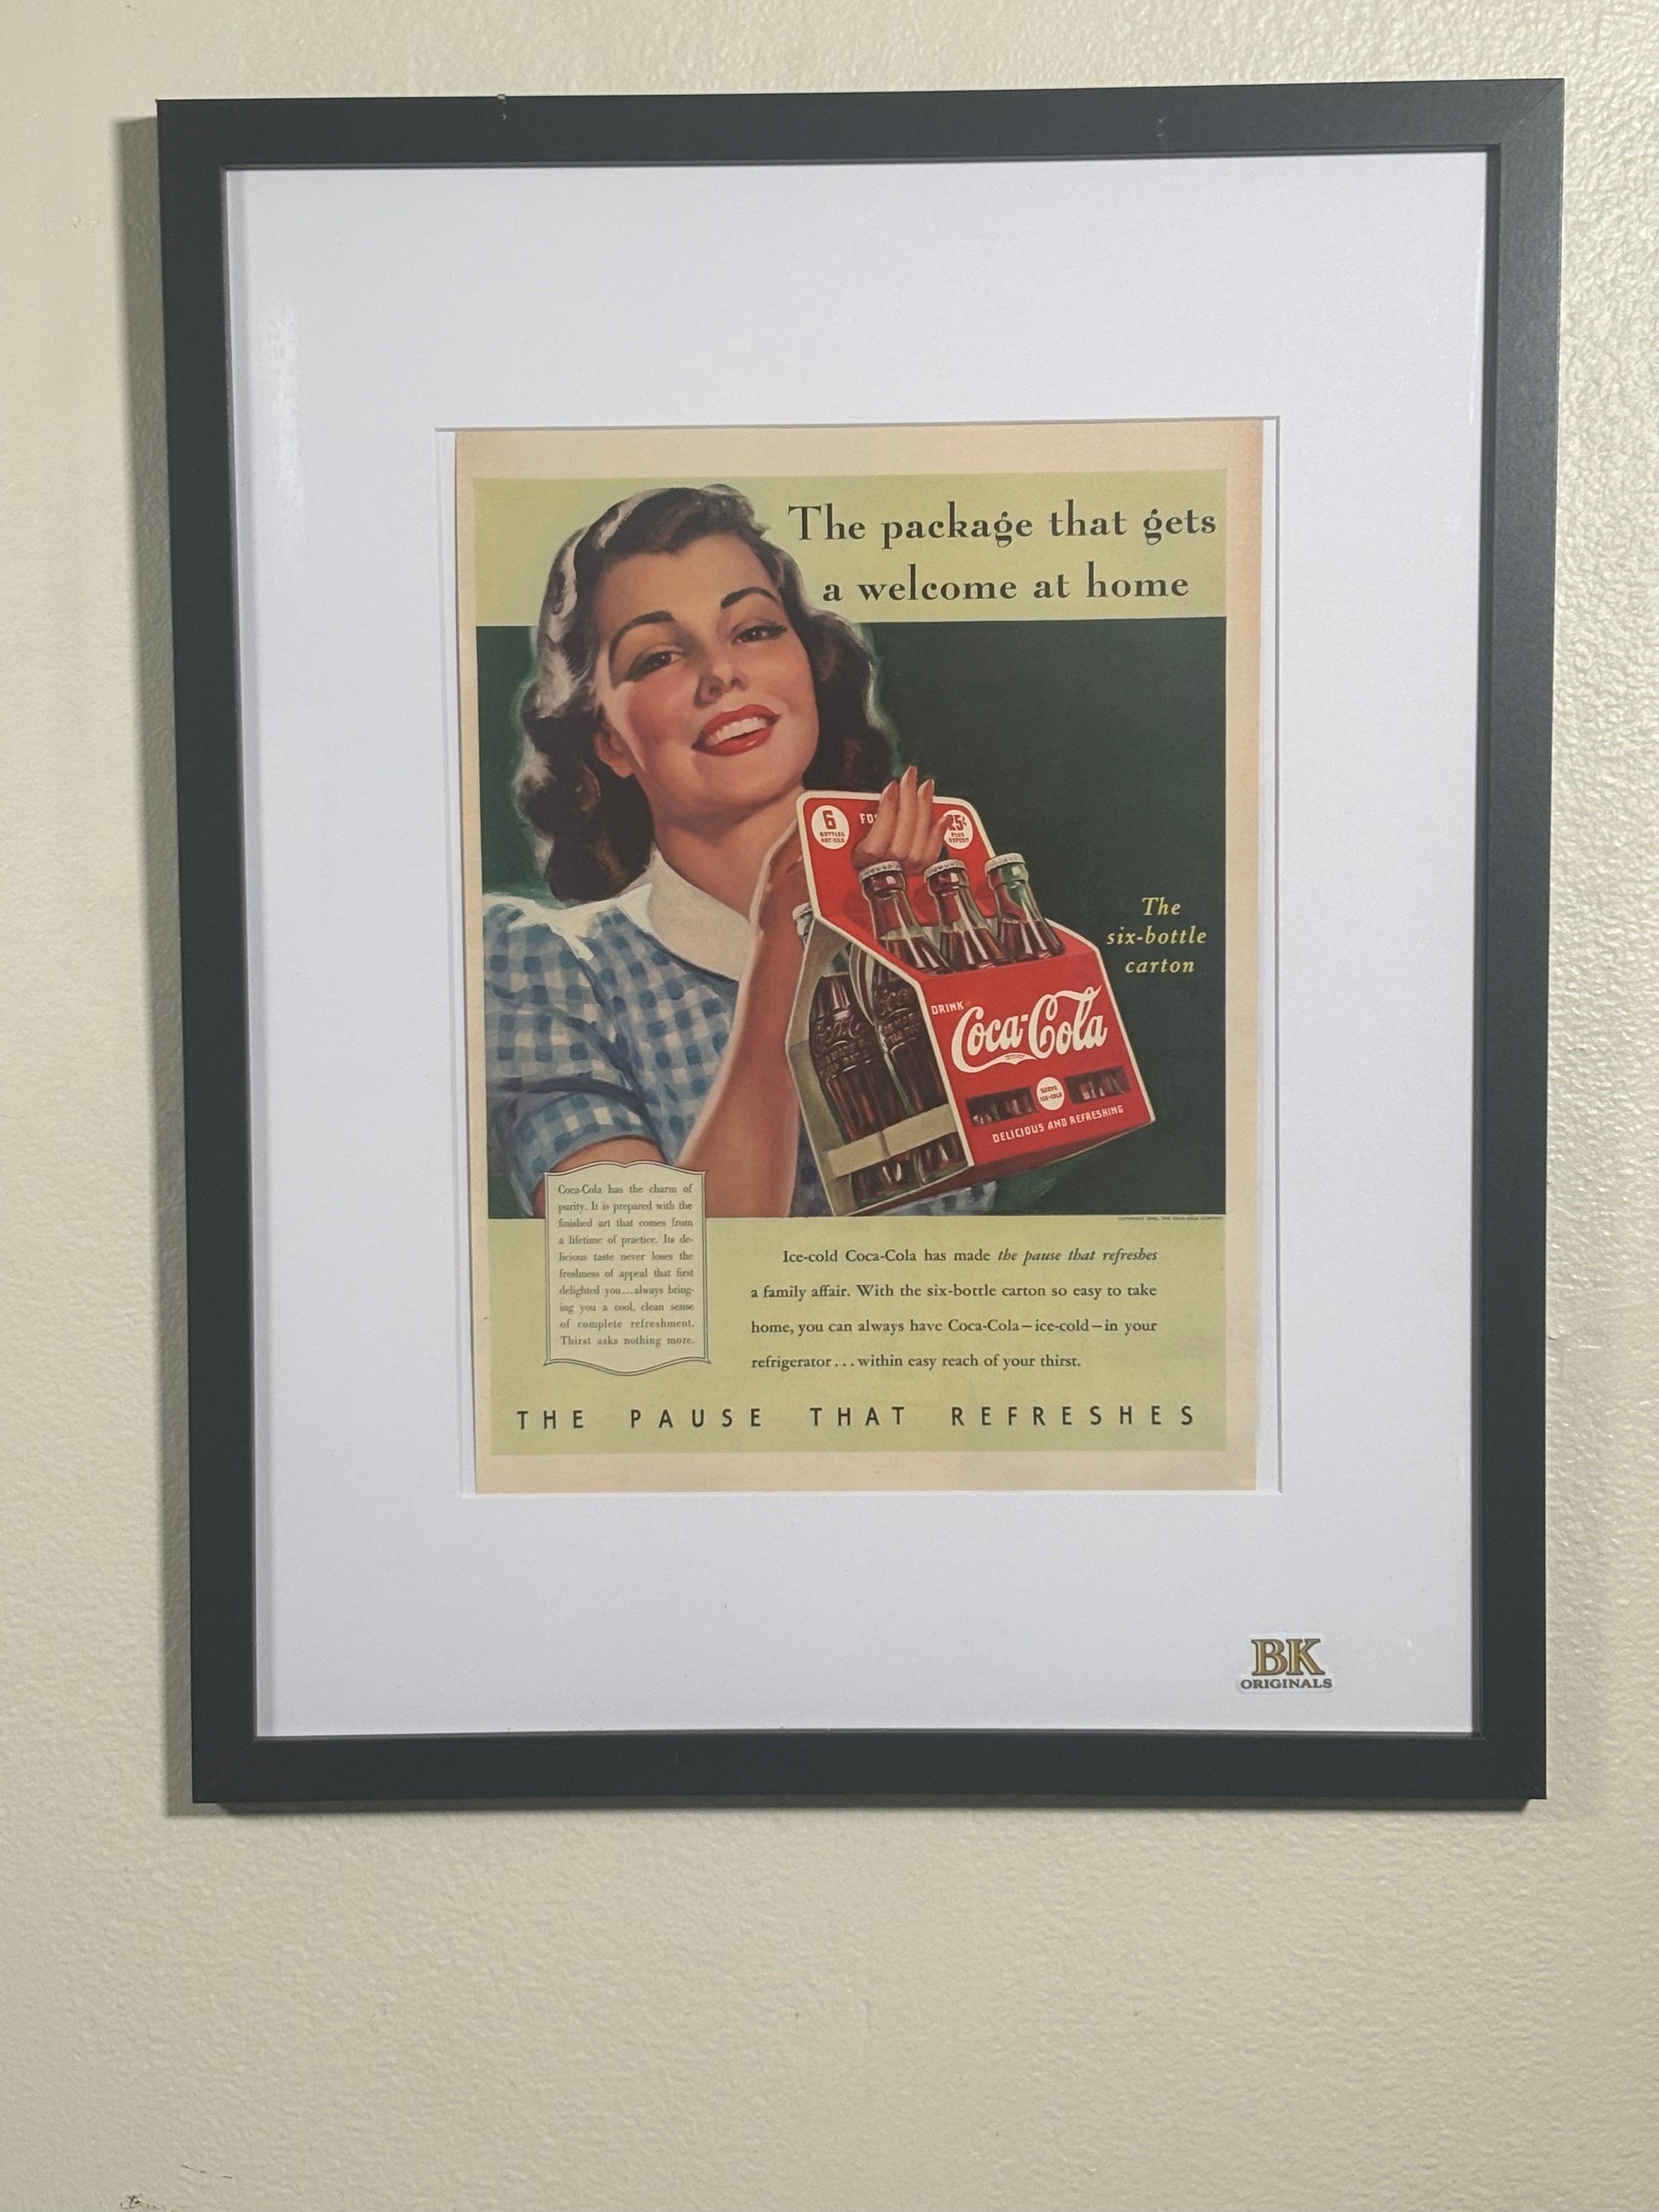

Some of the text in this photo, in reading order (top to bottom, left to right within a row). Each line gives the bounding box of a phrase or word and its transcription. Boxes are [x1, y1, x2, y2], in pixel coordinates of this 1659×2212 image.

[787, 499, 1216, 548] The package that gets
[823, 560, 1188, 601] a welcome at home
[822, 810, 837, 830] 6
[1142, 897, 1181, 915] The
[1107, 925, 1206, 945] six-bottle
[1125, 958, 1194, 973] carton
[931, 1001, 964, 1015] DRINK
[951, 985, 1108, 1073] Coca-Cola
[992, 1105, 1124, 1143] DELICIOUS AND REFRESHING
[558, 1183, 693, 1194] Coca-Cola has the charm of
[558, 1200, 692, 1214] purity. It is prepared with the
[558, 1218, 592, 1227] finished
[616, 1218, 633, 1227] that
[672, 1217, 693, 1227] from
[568, 1235, 603, 1244] lifetime
[607, 1234, 617, 1244] of
[621, 1235, 658, 1248] practice.
[663, 1234, 675, 1244] Its
[679, 1234, 693, 1243] de-
[559, 1252, 588, 1261] licious
[651, 1251, 673, 1261] loses
[679, 1250, 693, 1260] the
[782, 1248, 1158, 1266] Ice-cold Coca-Cola has made the pause that refreshes
[559, 1267, 693, 1281] freshness of appeal that first
[559, 1285, 600, 1298] delighted
[751, 1283, 1157, 1302] a family affair. With the six-bottle carton so easy to take
[560, 1302, 574, 1314] ing
[579, 1305, 596, 1314] you
[641, 1301, 664, 1311] clean
[559, 1318, 695, 1331] of complete refreshment.
[751, 1321, 794, 1335] home,
[798, 1324, 824, 1337] you
[828, 1323, 852, 1332] can
[858, 1319, 904, 1336] always
[910, 1319, 943, 1331] have
[1124, 1323, 1158, 1336] your
[560, 1335, 591, 1345] Thirst
[597, 1335, 618, 1345] asks
[624, 1335, 661, 1348] nothing
[857, 1354, 903, 1367] within
[908, 1358, 937, 1371] easy
[941, 1353, 979, 1367] reach
[984, 1353, 1000, 1367] of
[1002, 1357, 1035, 1371] your
[1040, 1354, 1081, 1367] thirst.
[517, 1406, 1193, 1430] THE PAUSE THAT REFRESHES
[1251, 1638, 1325, 1676] BK
[1240, 1678, 1333, 1689] ORIGINALS
